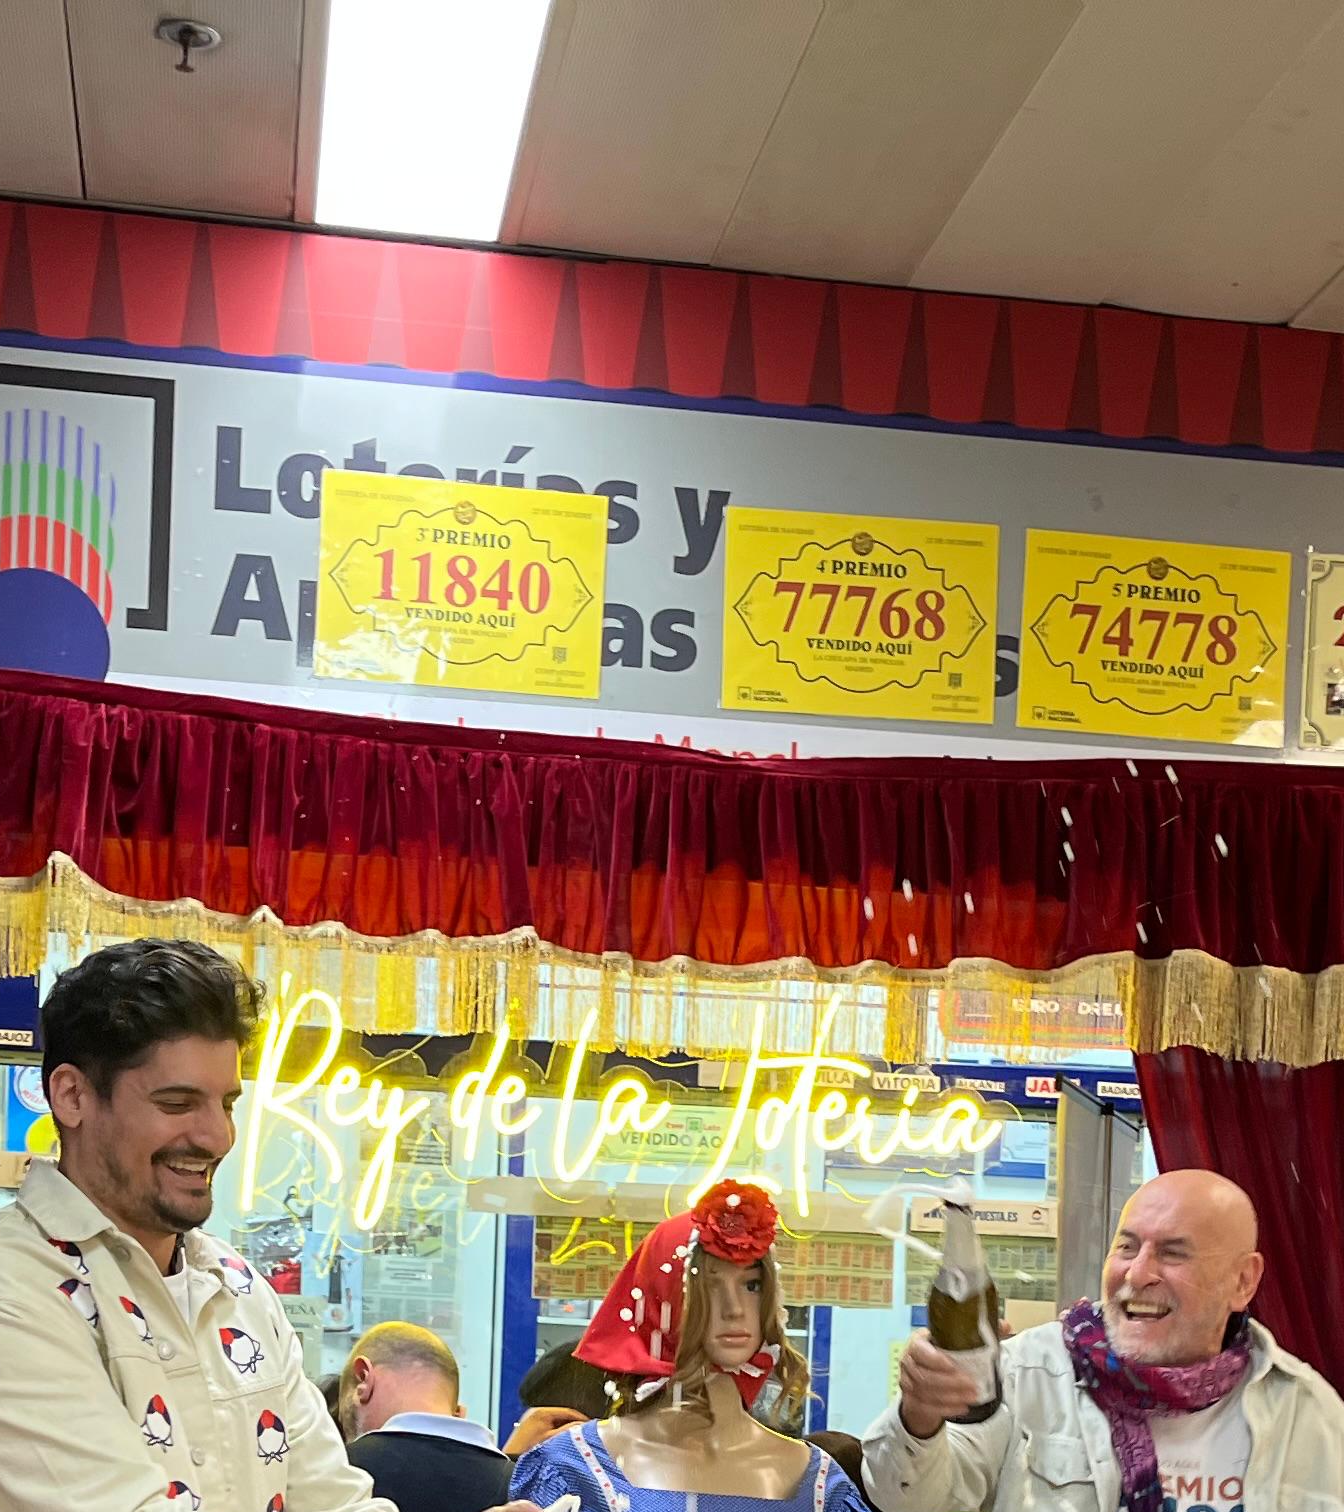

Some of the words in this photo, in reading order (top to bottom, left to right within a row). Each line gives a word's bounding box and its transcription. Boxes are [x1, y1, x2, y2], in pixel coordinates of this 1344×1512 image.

[432, 528, 511, 550] PREMIO
[832, 559, 907, 579] PREMIO
[372, 548, 551, 615] 11840
[1127, 584, 1201, 604] PREMIO
[405, 607, 473, 624] VENDIDO
[478, 612, 515, 629] AQUÍ
[773, 581, 946, 642] 77768
[1070, 604, 1238, 666] 74778
[806, 638, 872, 653] VENDIDO
[875, 642, 912, 656] AQUÍ
[1101, 660, 1163, 676] VENDIDO
[1167, 664, 1204, 679] AQUÍ
[875, 1071, 936, 1091] VITORIA
[239, 968, 430, 1230] Rey
[449, 1018, 550, 1162] de
[1100, 1085, 1140, 1098] BADAJO
[620, 1131, 694, 1147] VENDIDO
